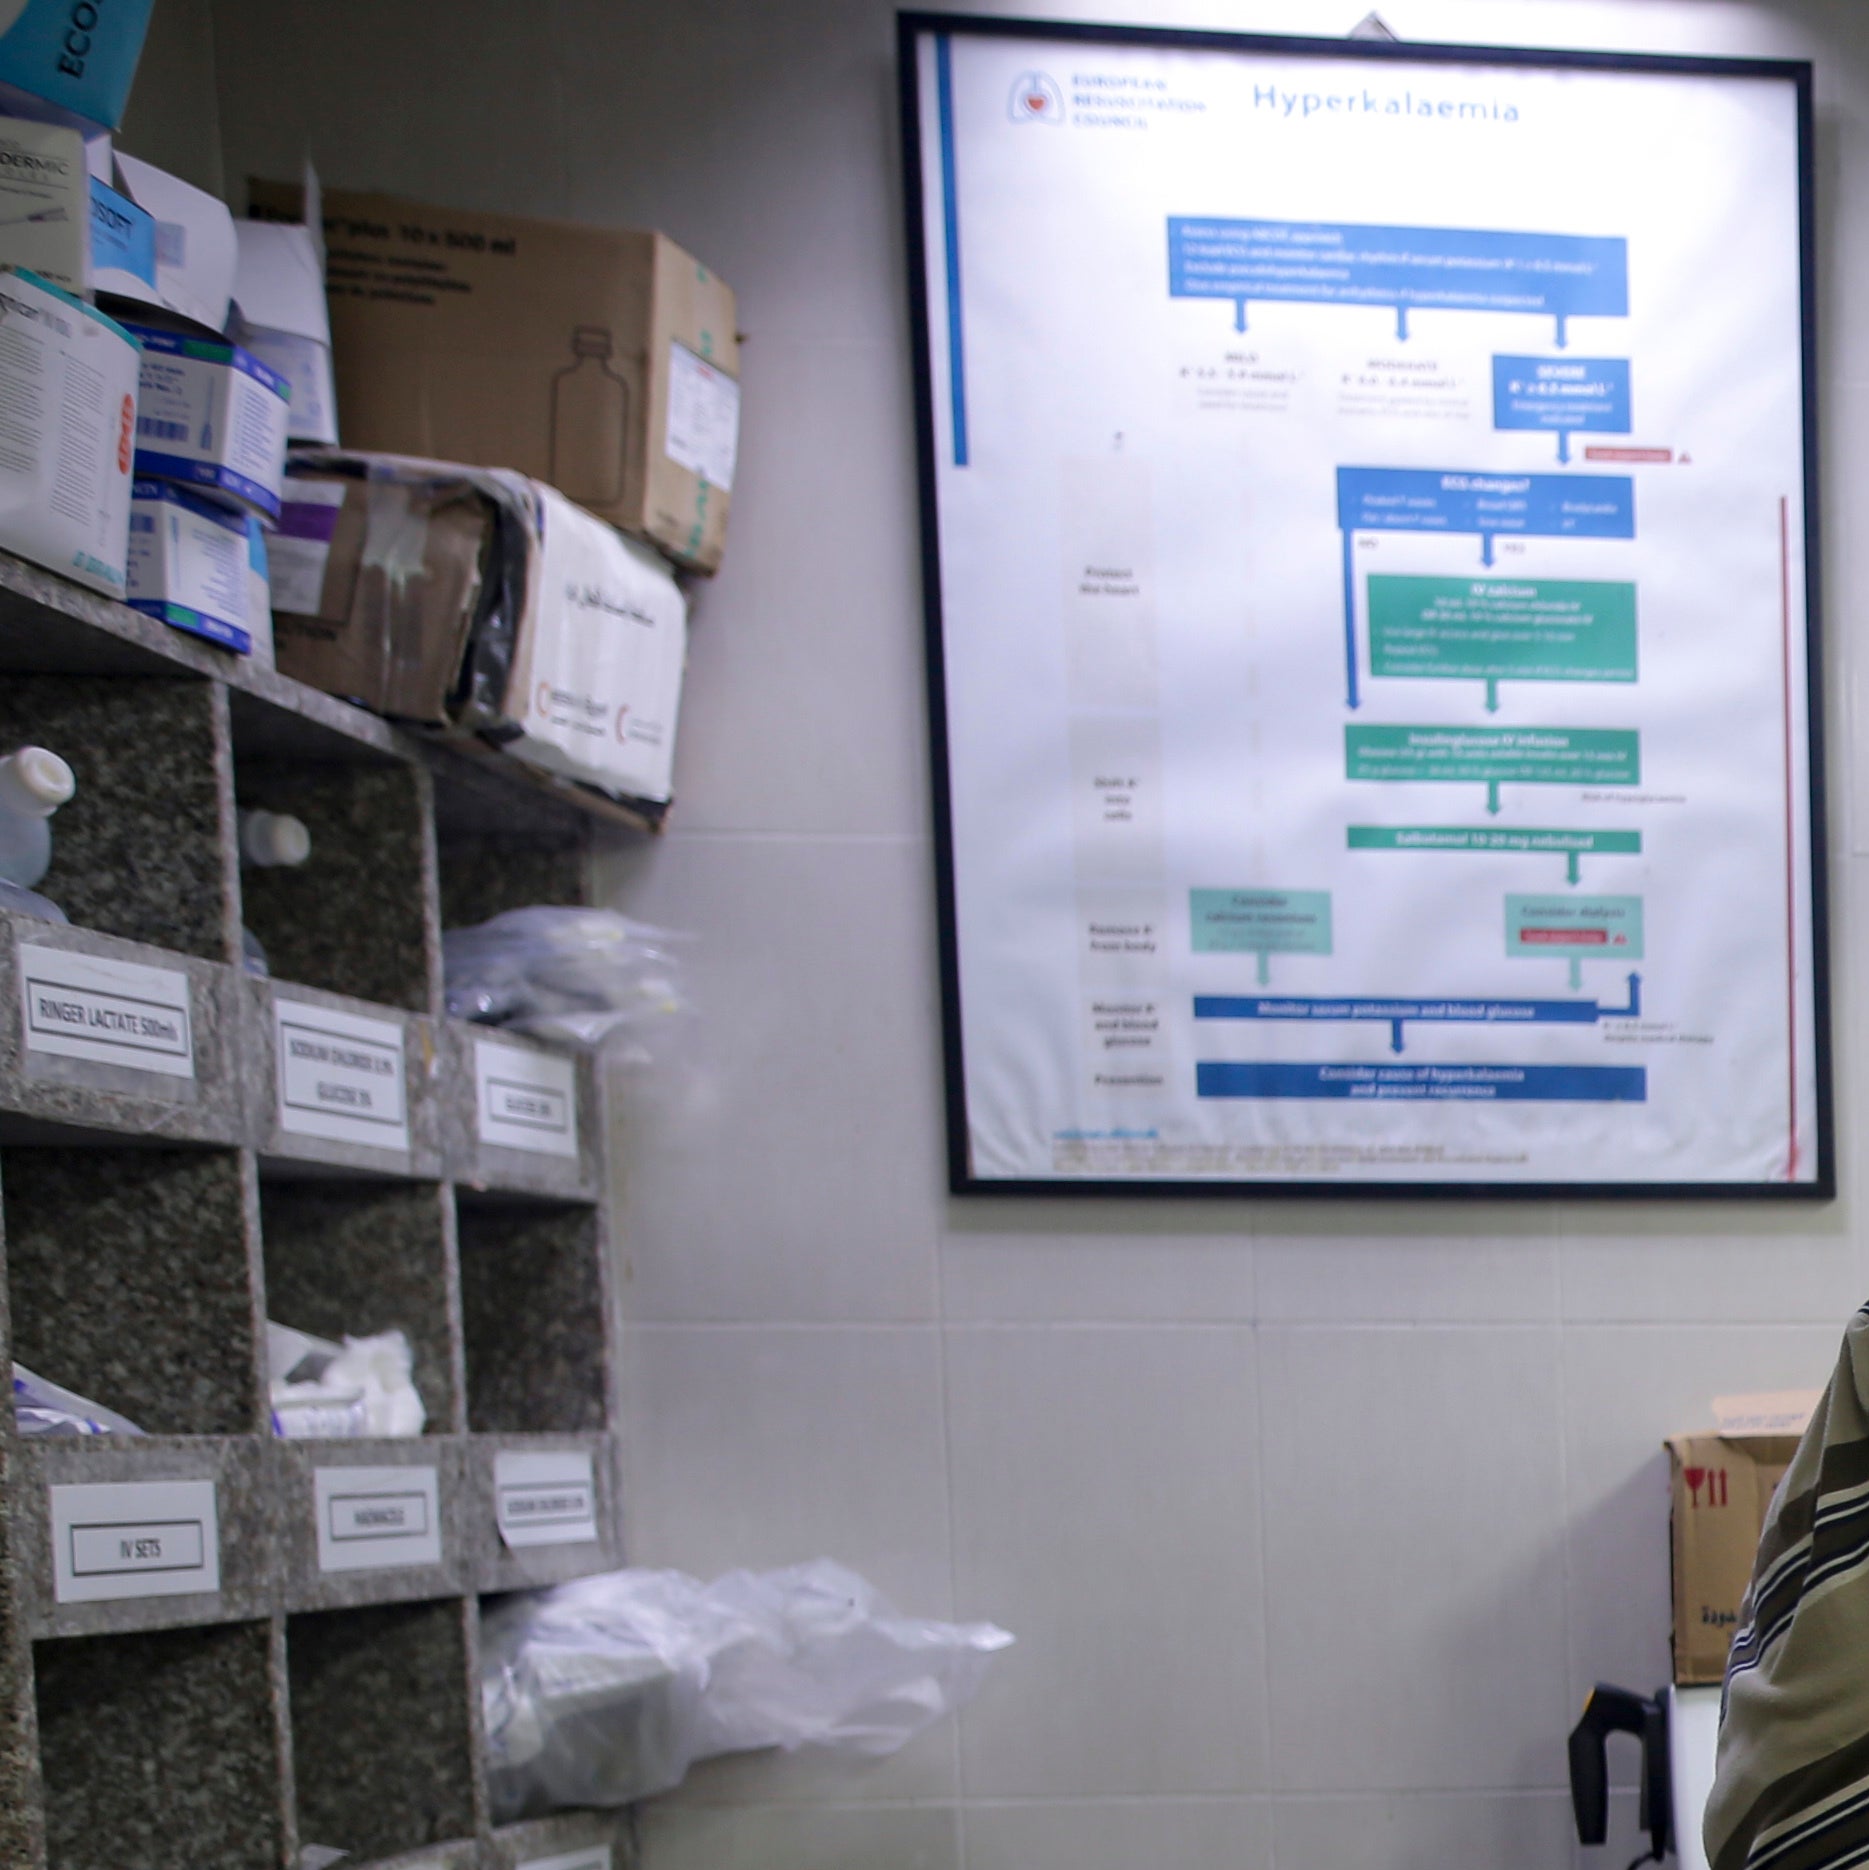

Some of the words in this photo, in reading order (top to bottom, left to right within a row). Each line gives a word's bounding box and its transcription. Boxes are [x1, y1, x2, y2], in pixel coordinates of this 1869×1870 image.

[57, 0, 99, 79] ECO
[1253, 83, 1521, 122] Hyperkalaemia
[0, 152, 71, 176] DERMIC
[39, 997, 86, 1025] RINGER
[88, 1006, 139, 1035] LACTATE
[120, 1540, 133, 1559] IV
[134, 1538, 161, 1559] SETS
